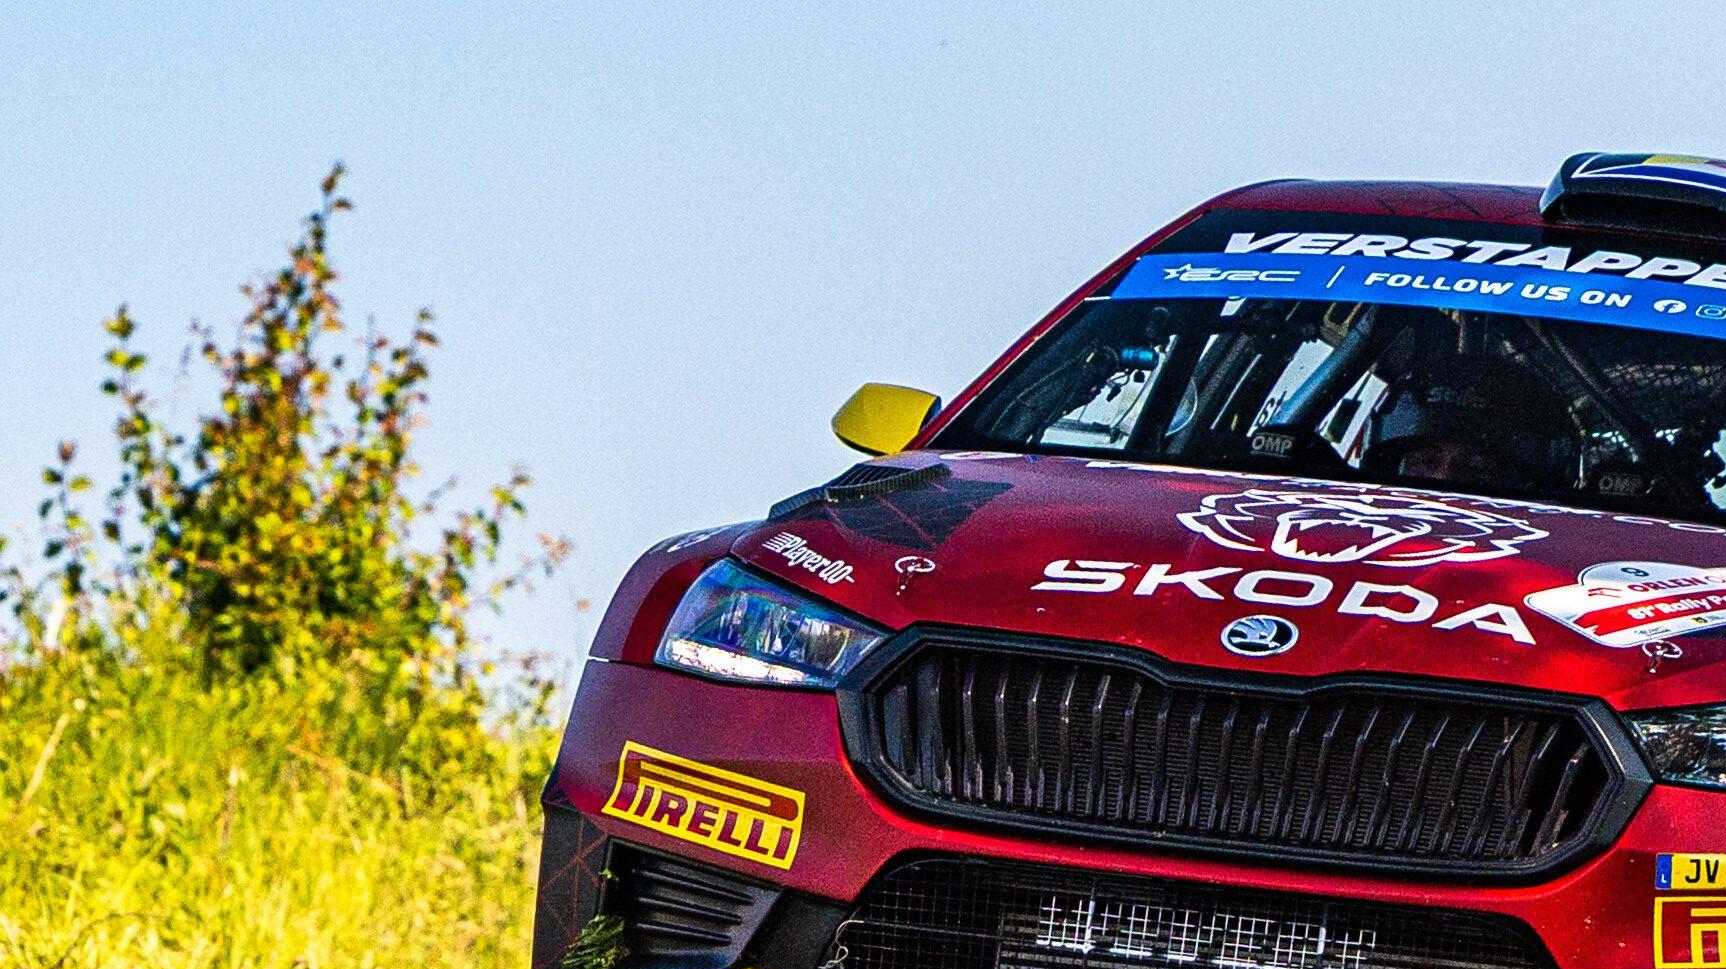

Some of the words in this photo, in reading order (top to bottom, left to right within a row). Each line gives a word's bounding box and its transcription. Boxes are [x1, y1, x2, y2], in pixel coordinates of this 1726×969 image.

[1364, 272, 1513, 295] FOLLOW
[1520, 283, 1570, 301] US
[1580, 290, 1632, 308] ON
[1627, 577, 1708, 593] ORLEN
[1654, 597, 1712, 614] Rally
[609, 746, 801, 864] PIRELLI
[1685, 858, 1719, 883] JV
